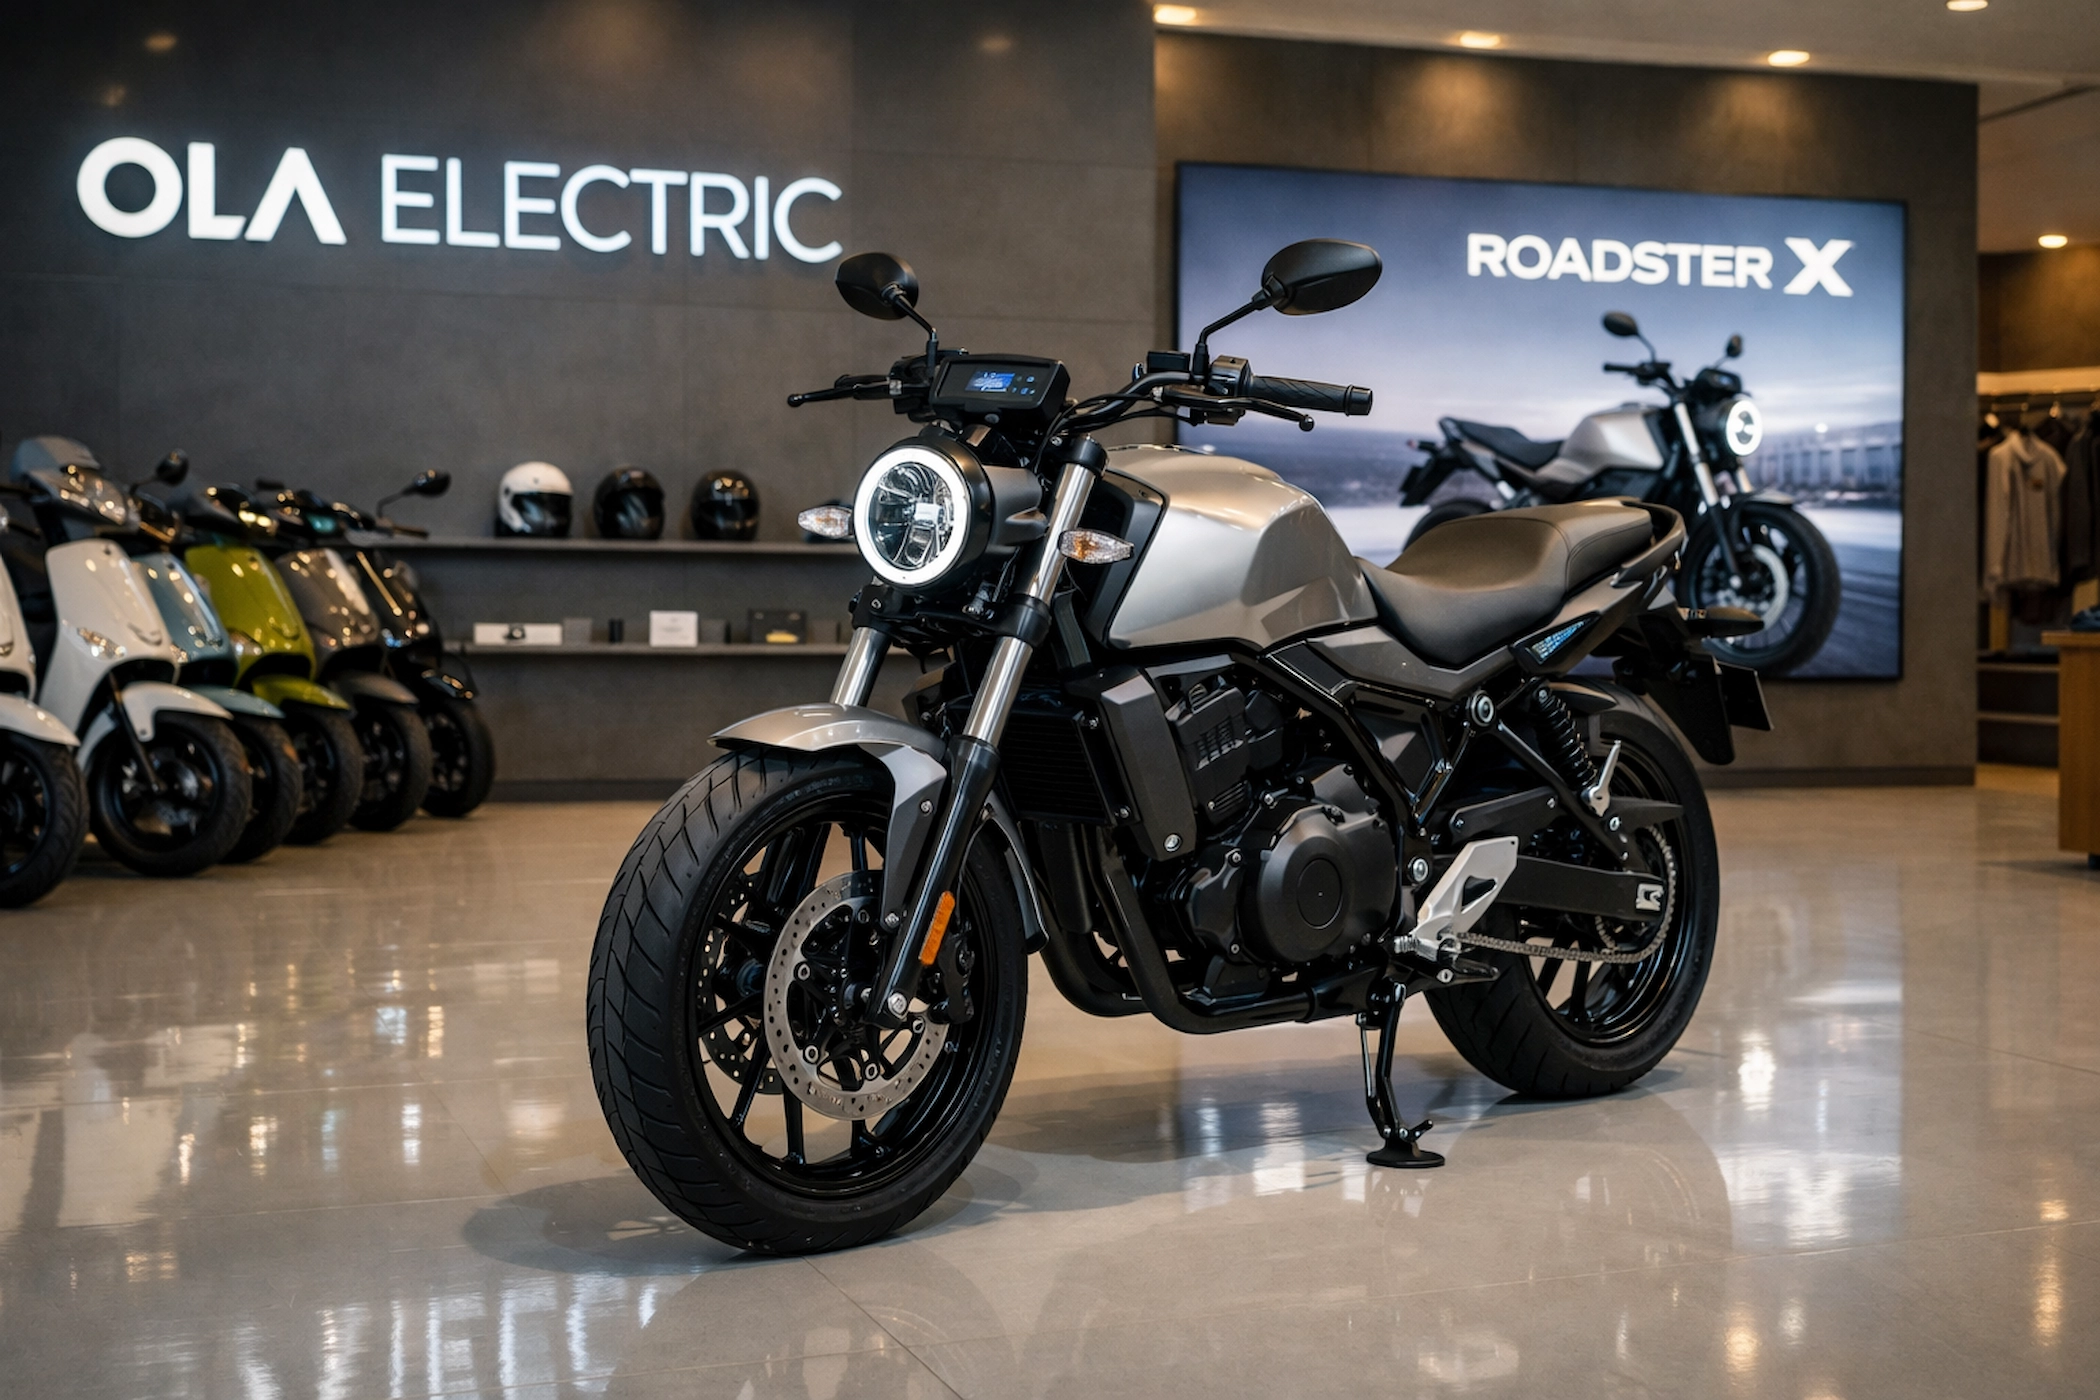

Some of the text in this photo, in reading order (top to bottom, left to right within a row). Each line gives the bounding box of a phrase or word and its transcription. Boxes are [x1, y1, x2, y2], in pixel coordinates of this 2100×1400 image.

[77, 137, 843, 263] OLA ELECTRIC
[1466, 232, 1855, 298] ROADSTER X
